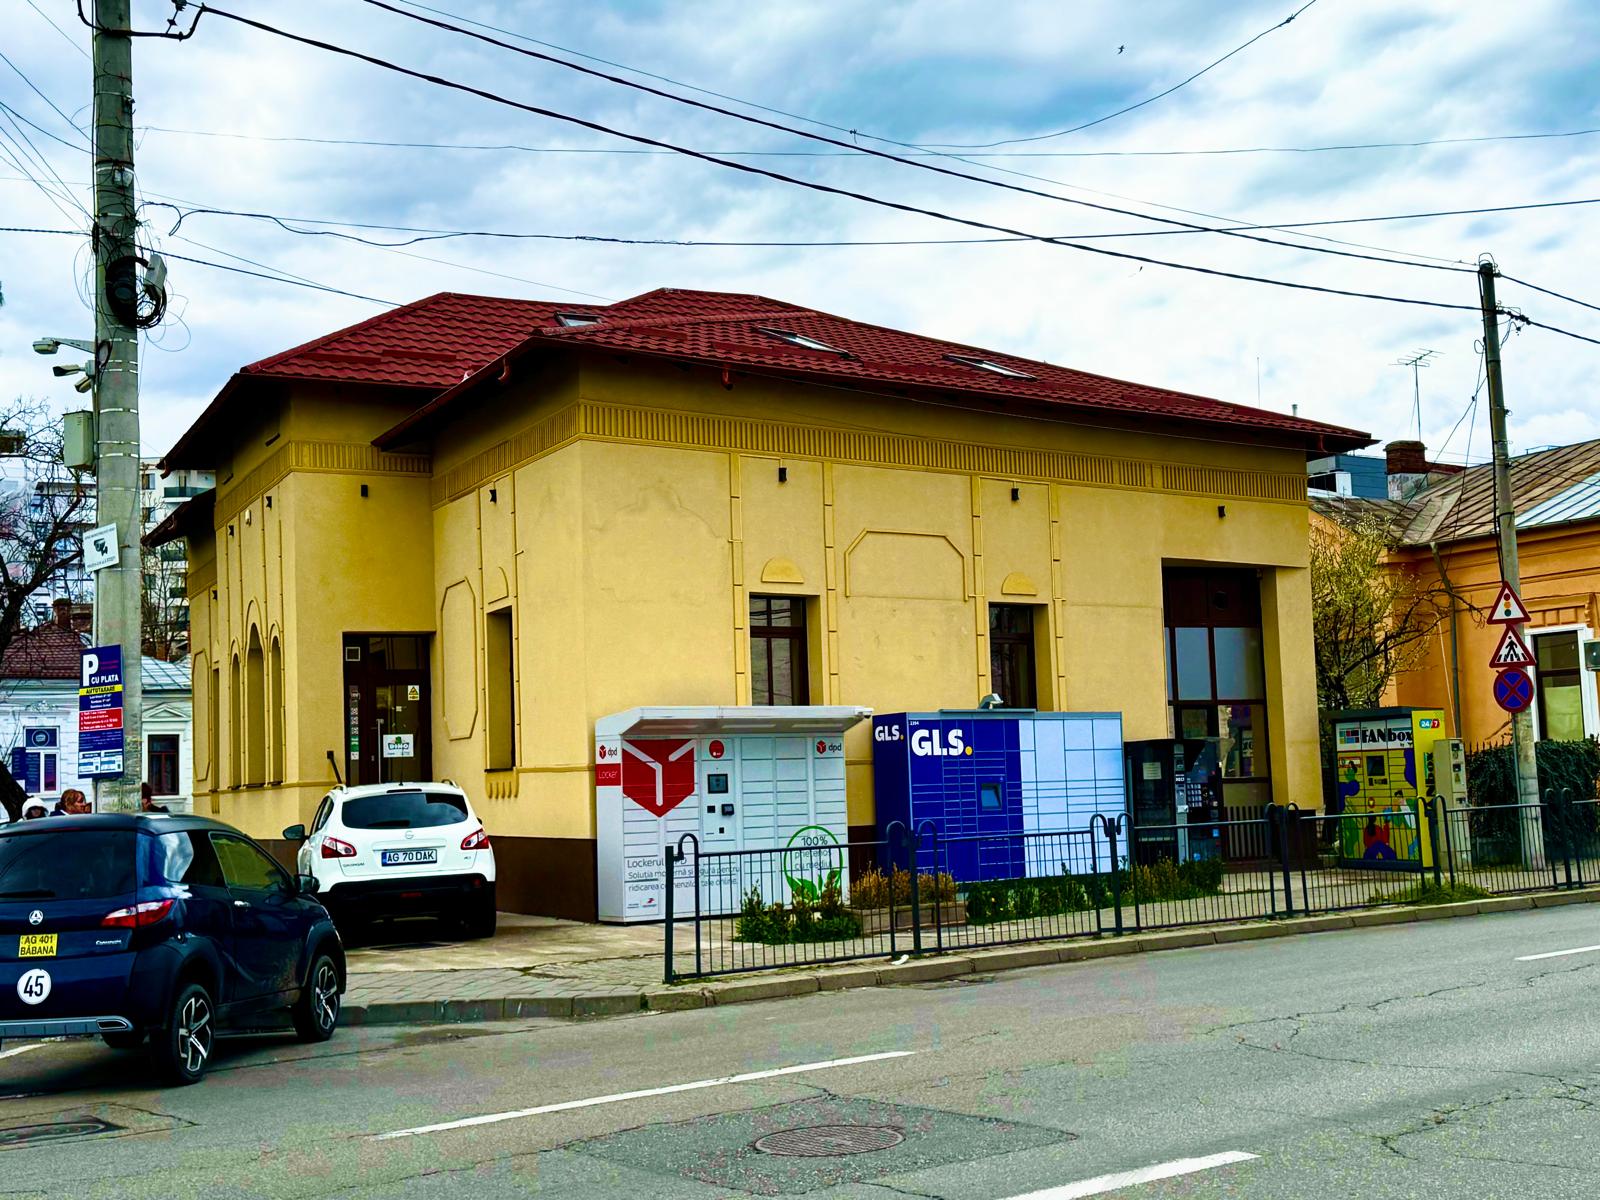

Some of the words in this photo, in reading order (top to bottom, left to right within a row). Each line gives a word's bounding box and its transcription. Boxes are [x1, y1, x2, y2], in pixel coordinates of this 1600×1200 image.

[83, 654, 98, 687] P
[91, 676, 100, 684] CU
[607, 747, 618, 758] dpd
[828, 743, 842, 754] dpd
[800, 836, 828, 846] 100%
[387, 852, 400, 862] AG
[402, 851, 413, 861] 70
[415, 850, 434, 860] DAK
[627, 858, 665, 868] Lockerul
[24, 936, 36, 944] AG
[39, 936, 54, 944] 401
[23, 975, 45, 998] 45
